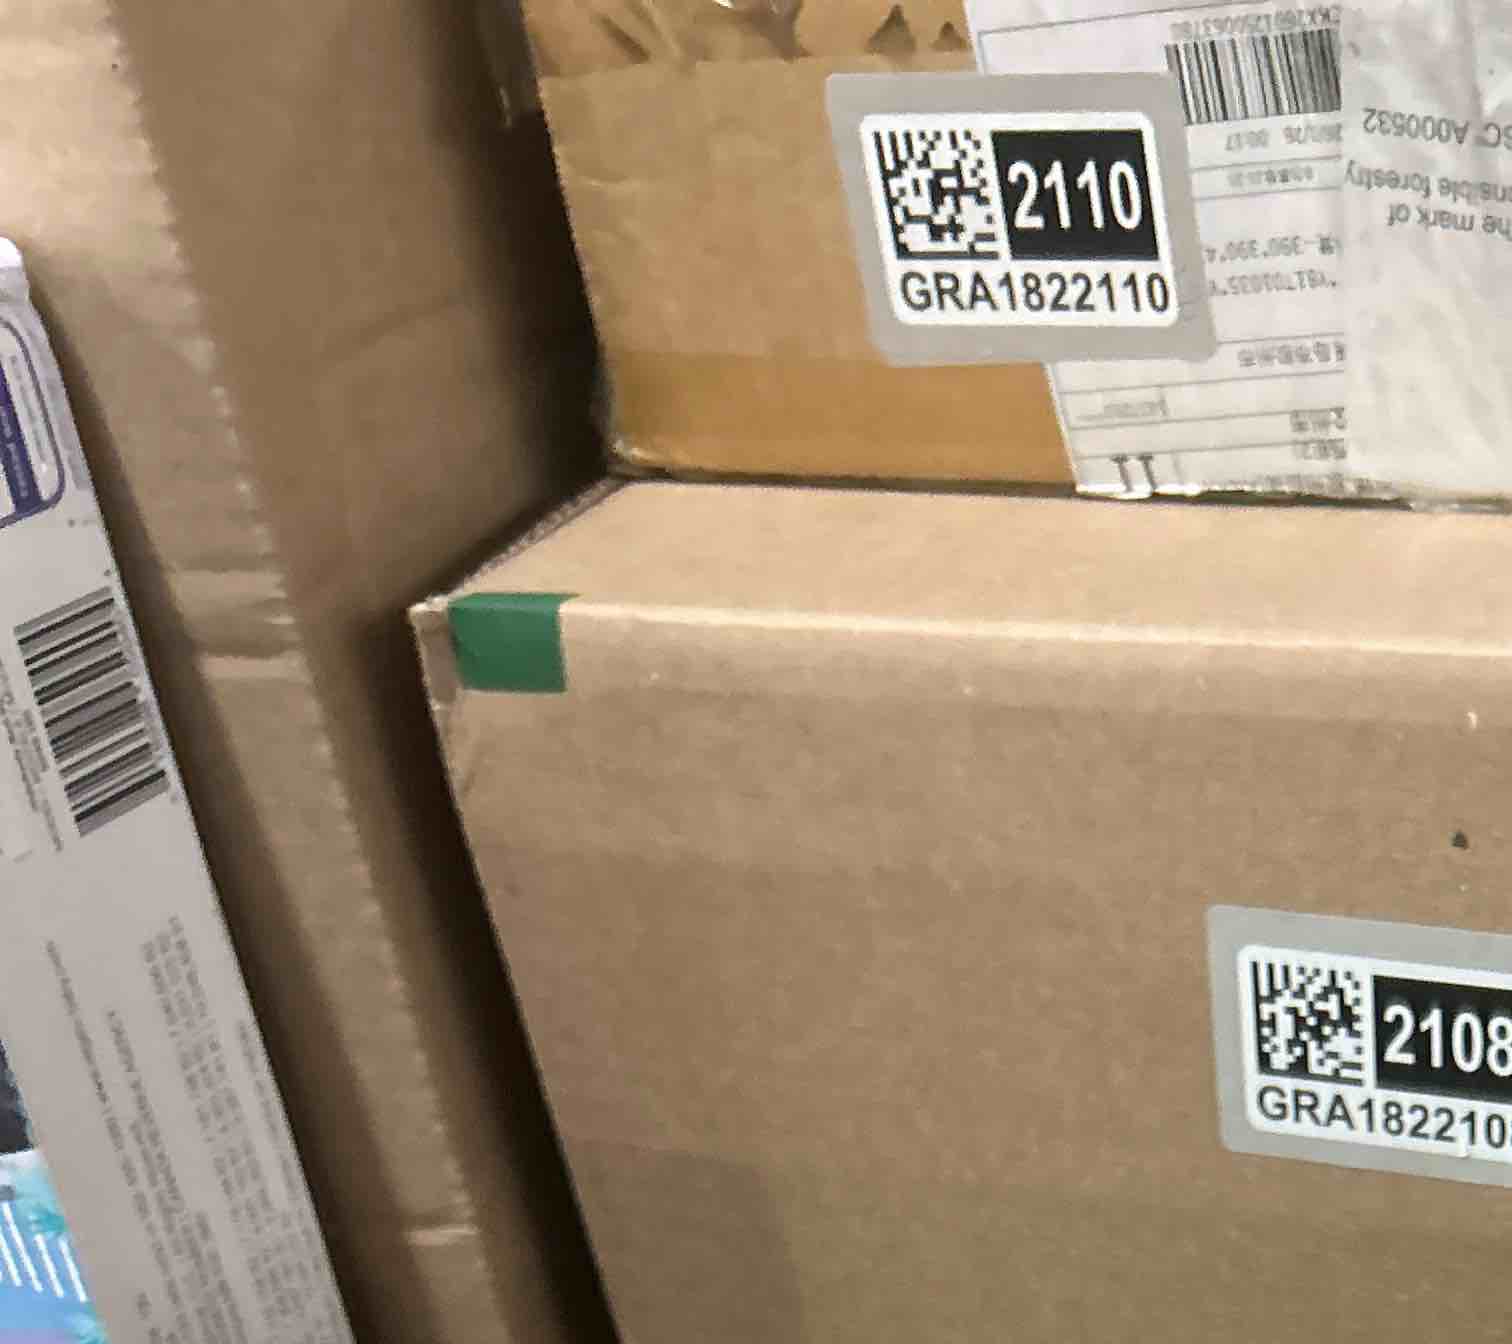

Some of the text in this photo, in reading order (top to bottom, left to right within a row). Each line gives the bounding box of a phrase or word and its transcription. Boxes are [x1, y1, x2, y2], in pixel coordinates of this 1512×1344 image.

[1363, 108, 1470, 146] A000532
[1006, 159, 1142, 230] 2110
[1344, 159, 1432, 201] forestry
[1387, 202, 1412, 227] of
[1417, 206, 1475, 234] mark
[900, 271, 1171, 314] GRA1822110
